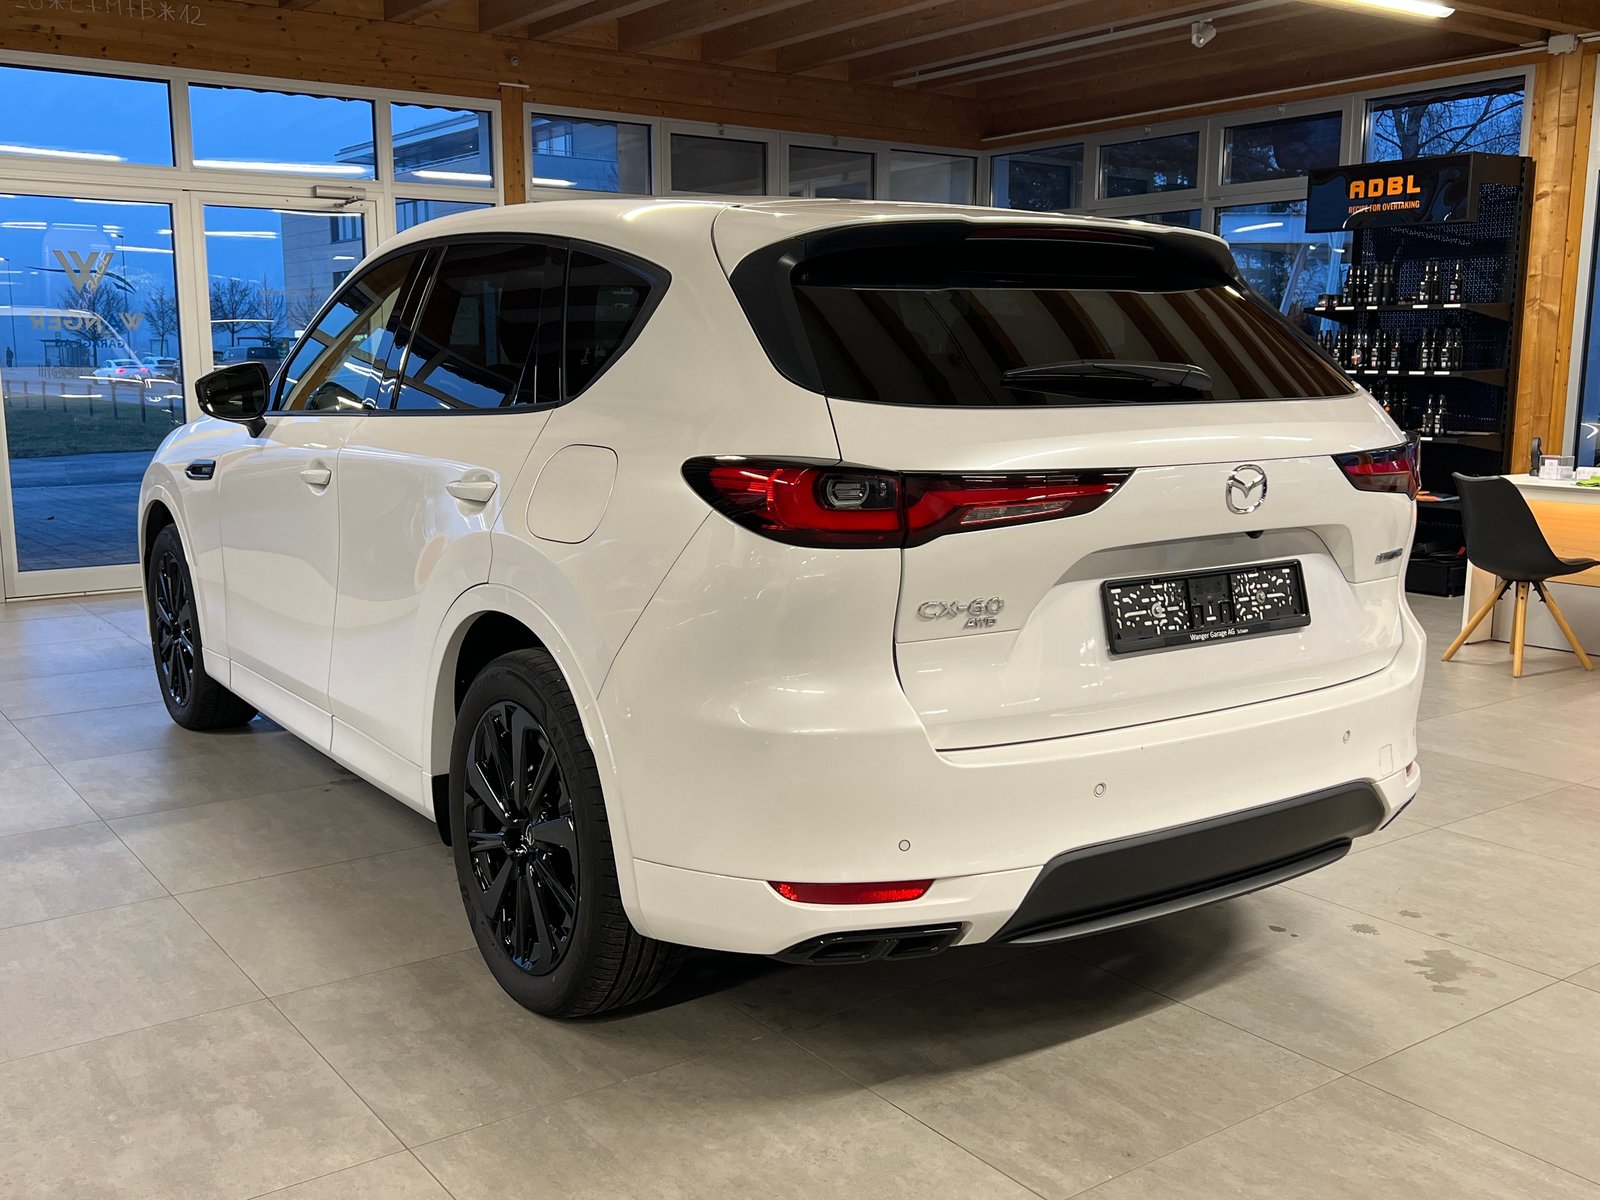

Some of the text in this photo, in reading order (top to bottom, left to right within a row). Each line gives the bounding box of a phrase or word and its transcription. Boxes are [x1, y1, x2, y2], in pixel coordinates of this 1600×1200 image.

[1349, 175, 1421, 200] ADBL
[1369, 203, 1381, 212] FOR
[1382, 200, 1420, 211] OVERTAKING
[917, 597, 1004, 620] CX-60
[1190, 633, 1209, 641] Wanger
